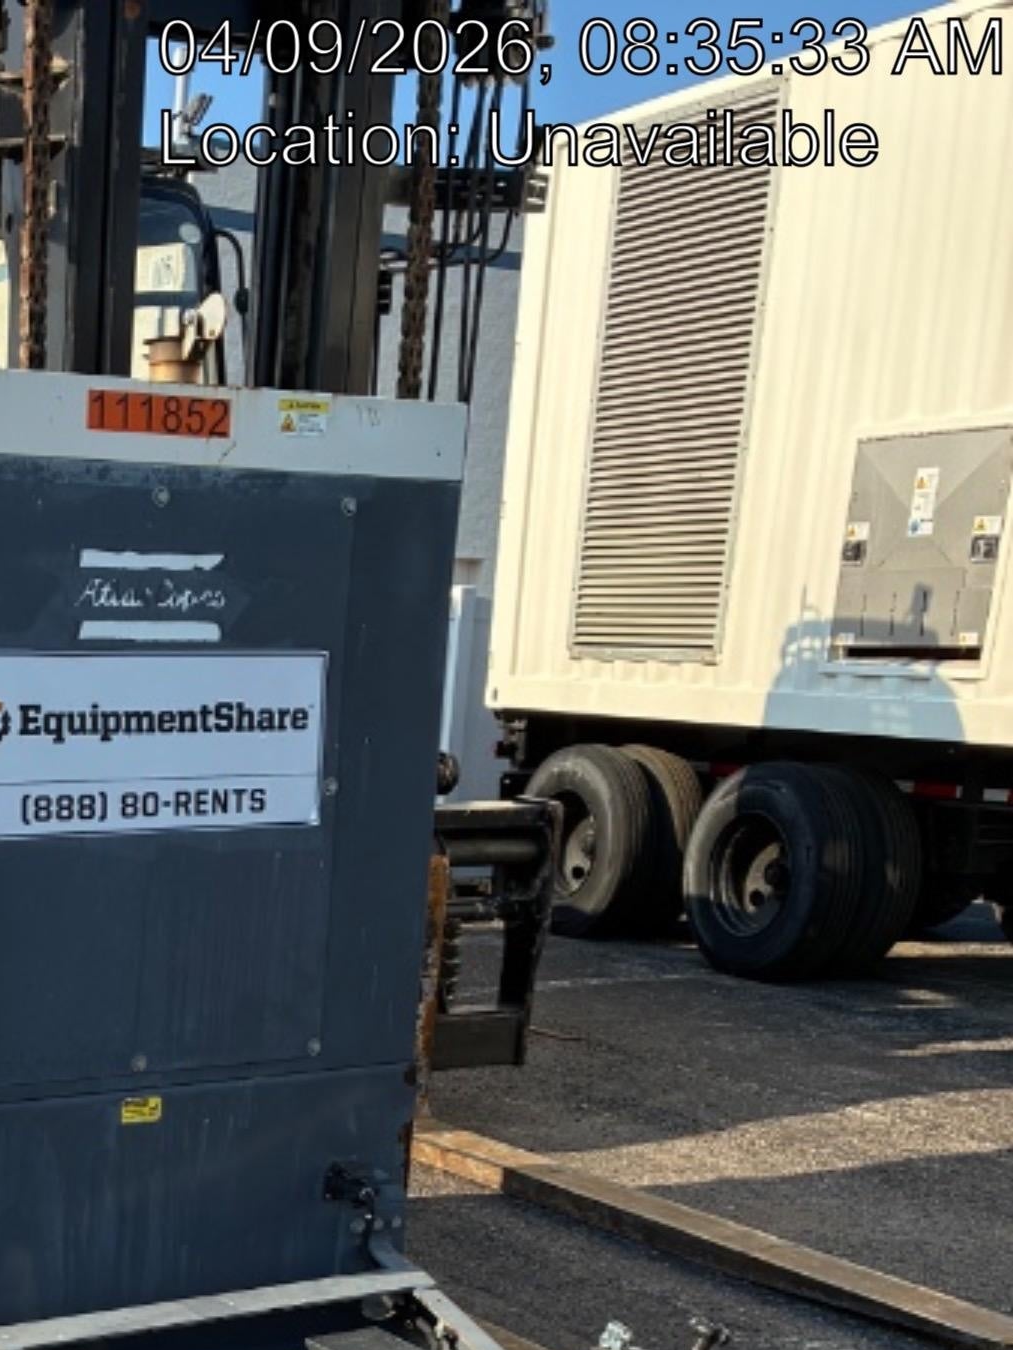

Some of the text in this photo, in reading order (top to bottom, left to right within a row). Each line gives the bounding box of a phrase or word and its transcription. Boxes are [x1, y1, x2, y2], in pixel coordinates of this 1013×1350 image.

[91, 391, 229, 436] 111852
[18, 701, 310, 744] EquipmentShare
[21, 788, 267, 825] (888) 80-RENTS
